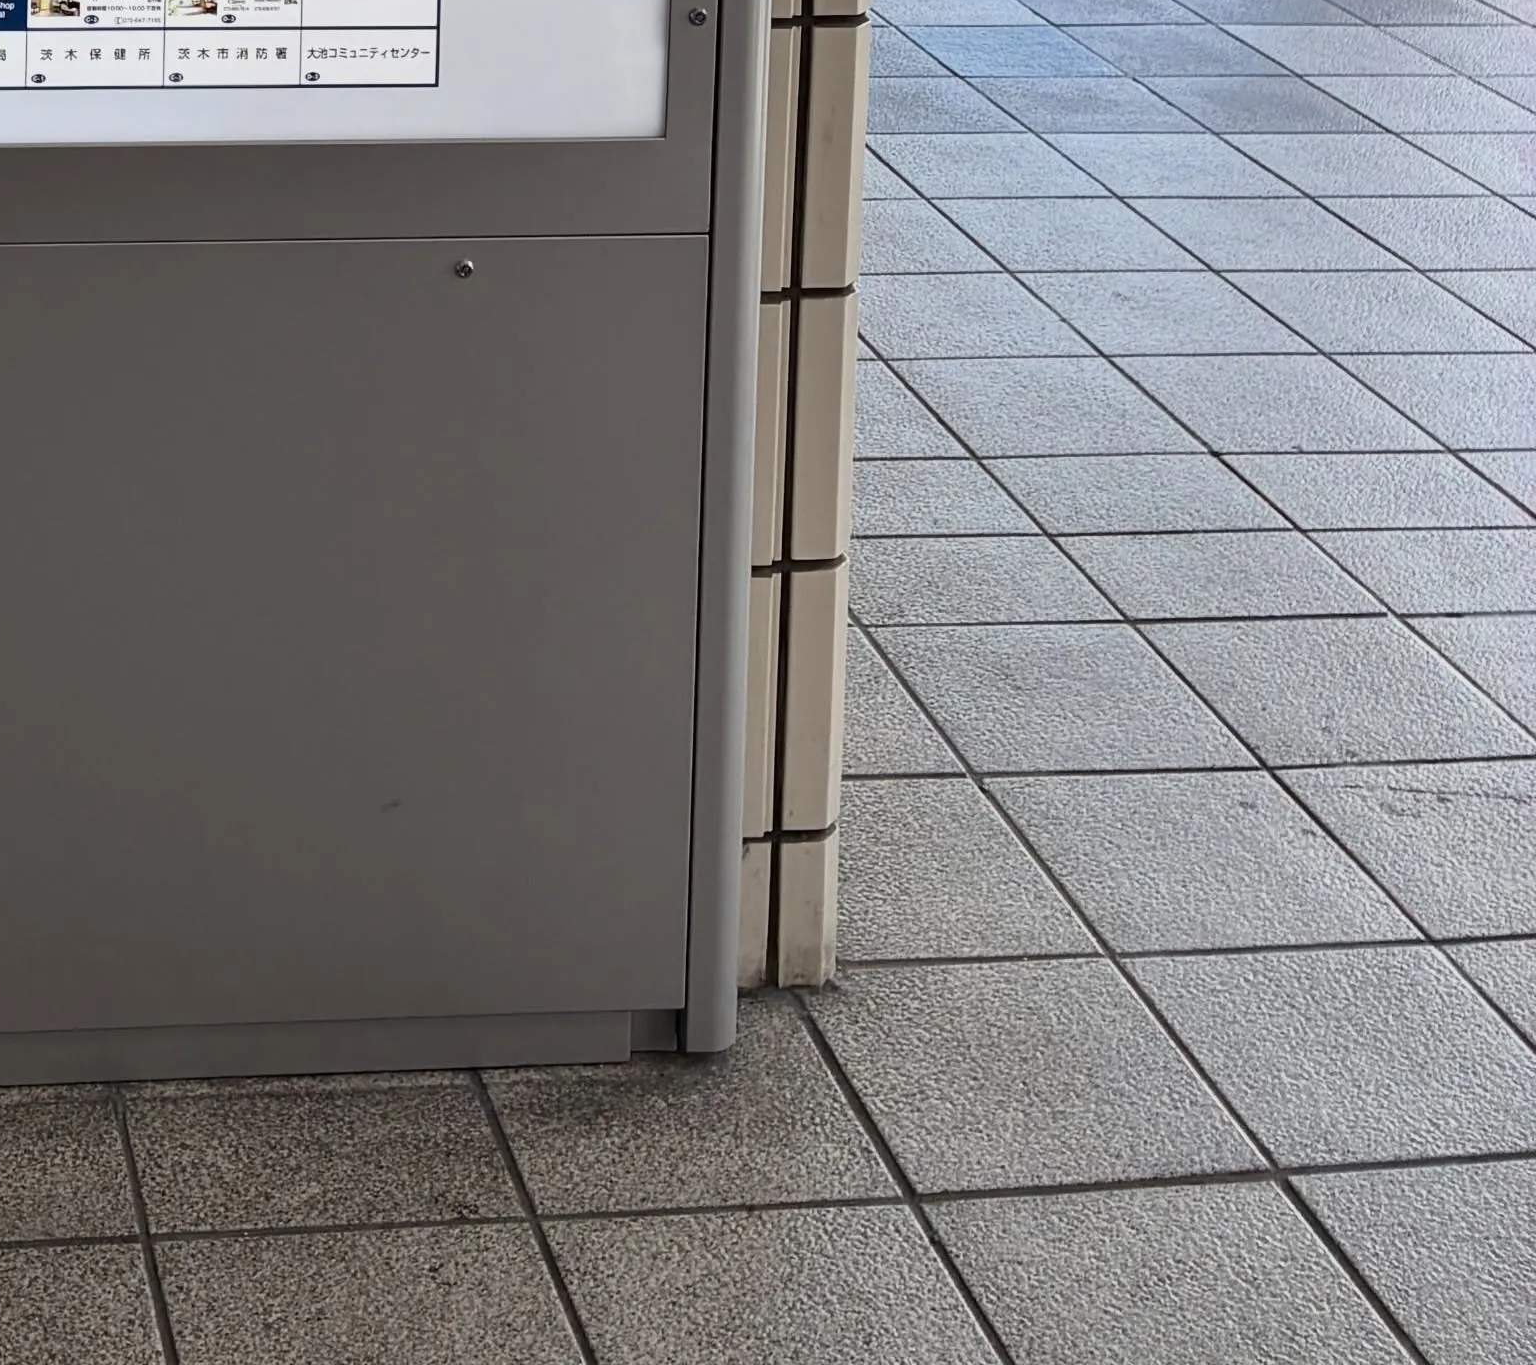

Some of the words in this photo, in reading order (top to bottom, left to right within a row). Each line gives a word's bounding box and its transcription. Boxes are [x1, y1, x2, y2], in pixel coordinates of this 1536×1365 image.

[40, 49, 150, 60] 茨木保健所
[177, 48, 287, 60] 茨木市消防署
[307, 48, 430, 59] 大池コミュニティセンター
